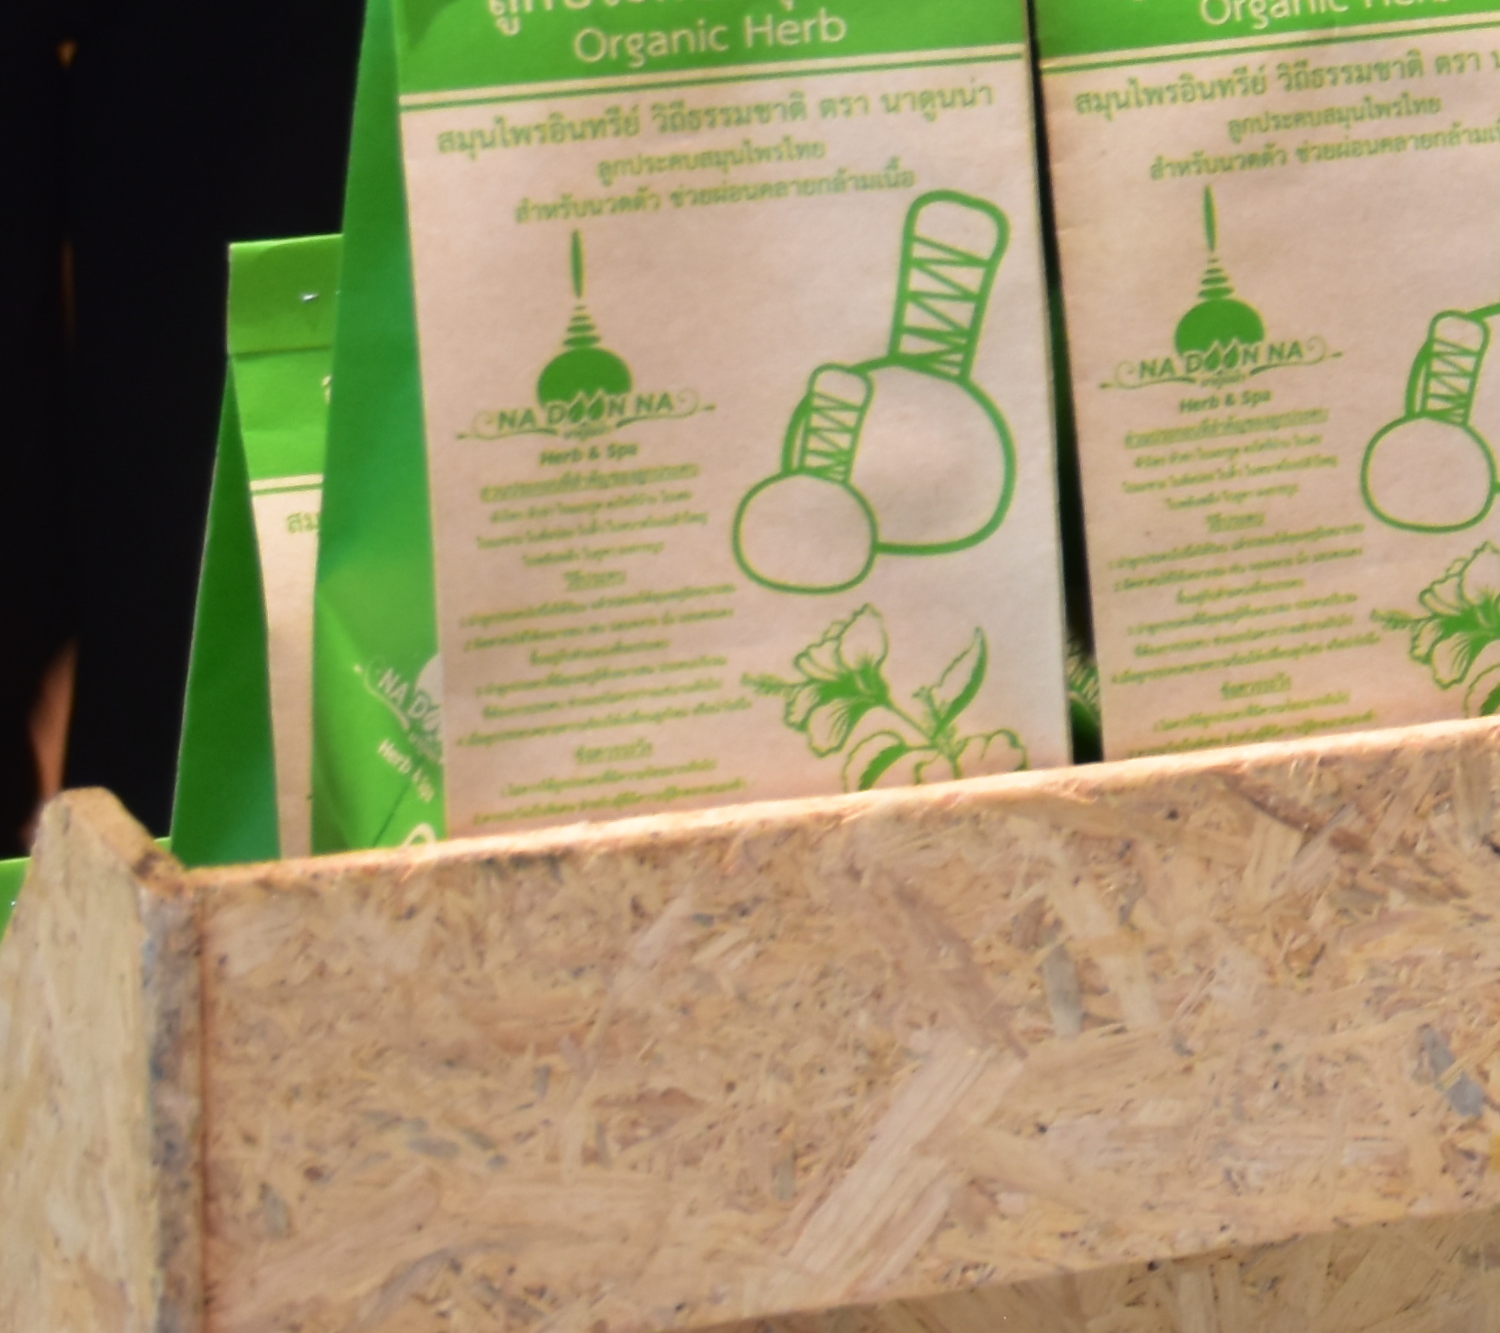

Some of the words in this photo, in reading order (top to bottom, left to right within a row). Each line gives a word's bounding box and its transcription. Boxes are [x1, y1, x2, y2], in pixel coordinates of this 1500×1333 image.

[574, 18, 729, 68] Organic
[744, 9, 847, 50] Herb
[1075, 64, 1266, 122] สมุนไพรอินทรีย์
[1435, 52, 1480, 78] ตรา
[1138, 357, 1176, 378] NA
[1268, 341, 1303, 363] NA
[497, 409, 536, 430] NA
[636, 393, 673, 413] NA
[1179, 395, 1219, 413] Herb
[1225, 393, 1235, 406] &
[1241, 390, 1272, 408] Spa
